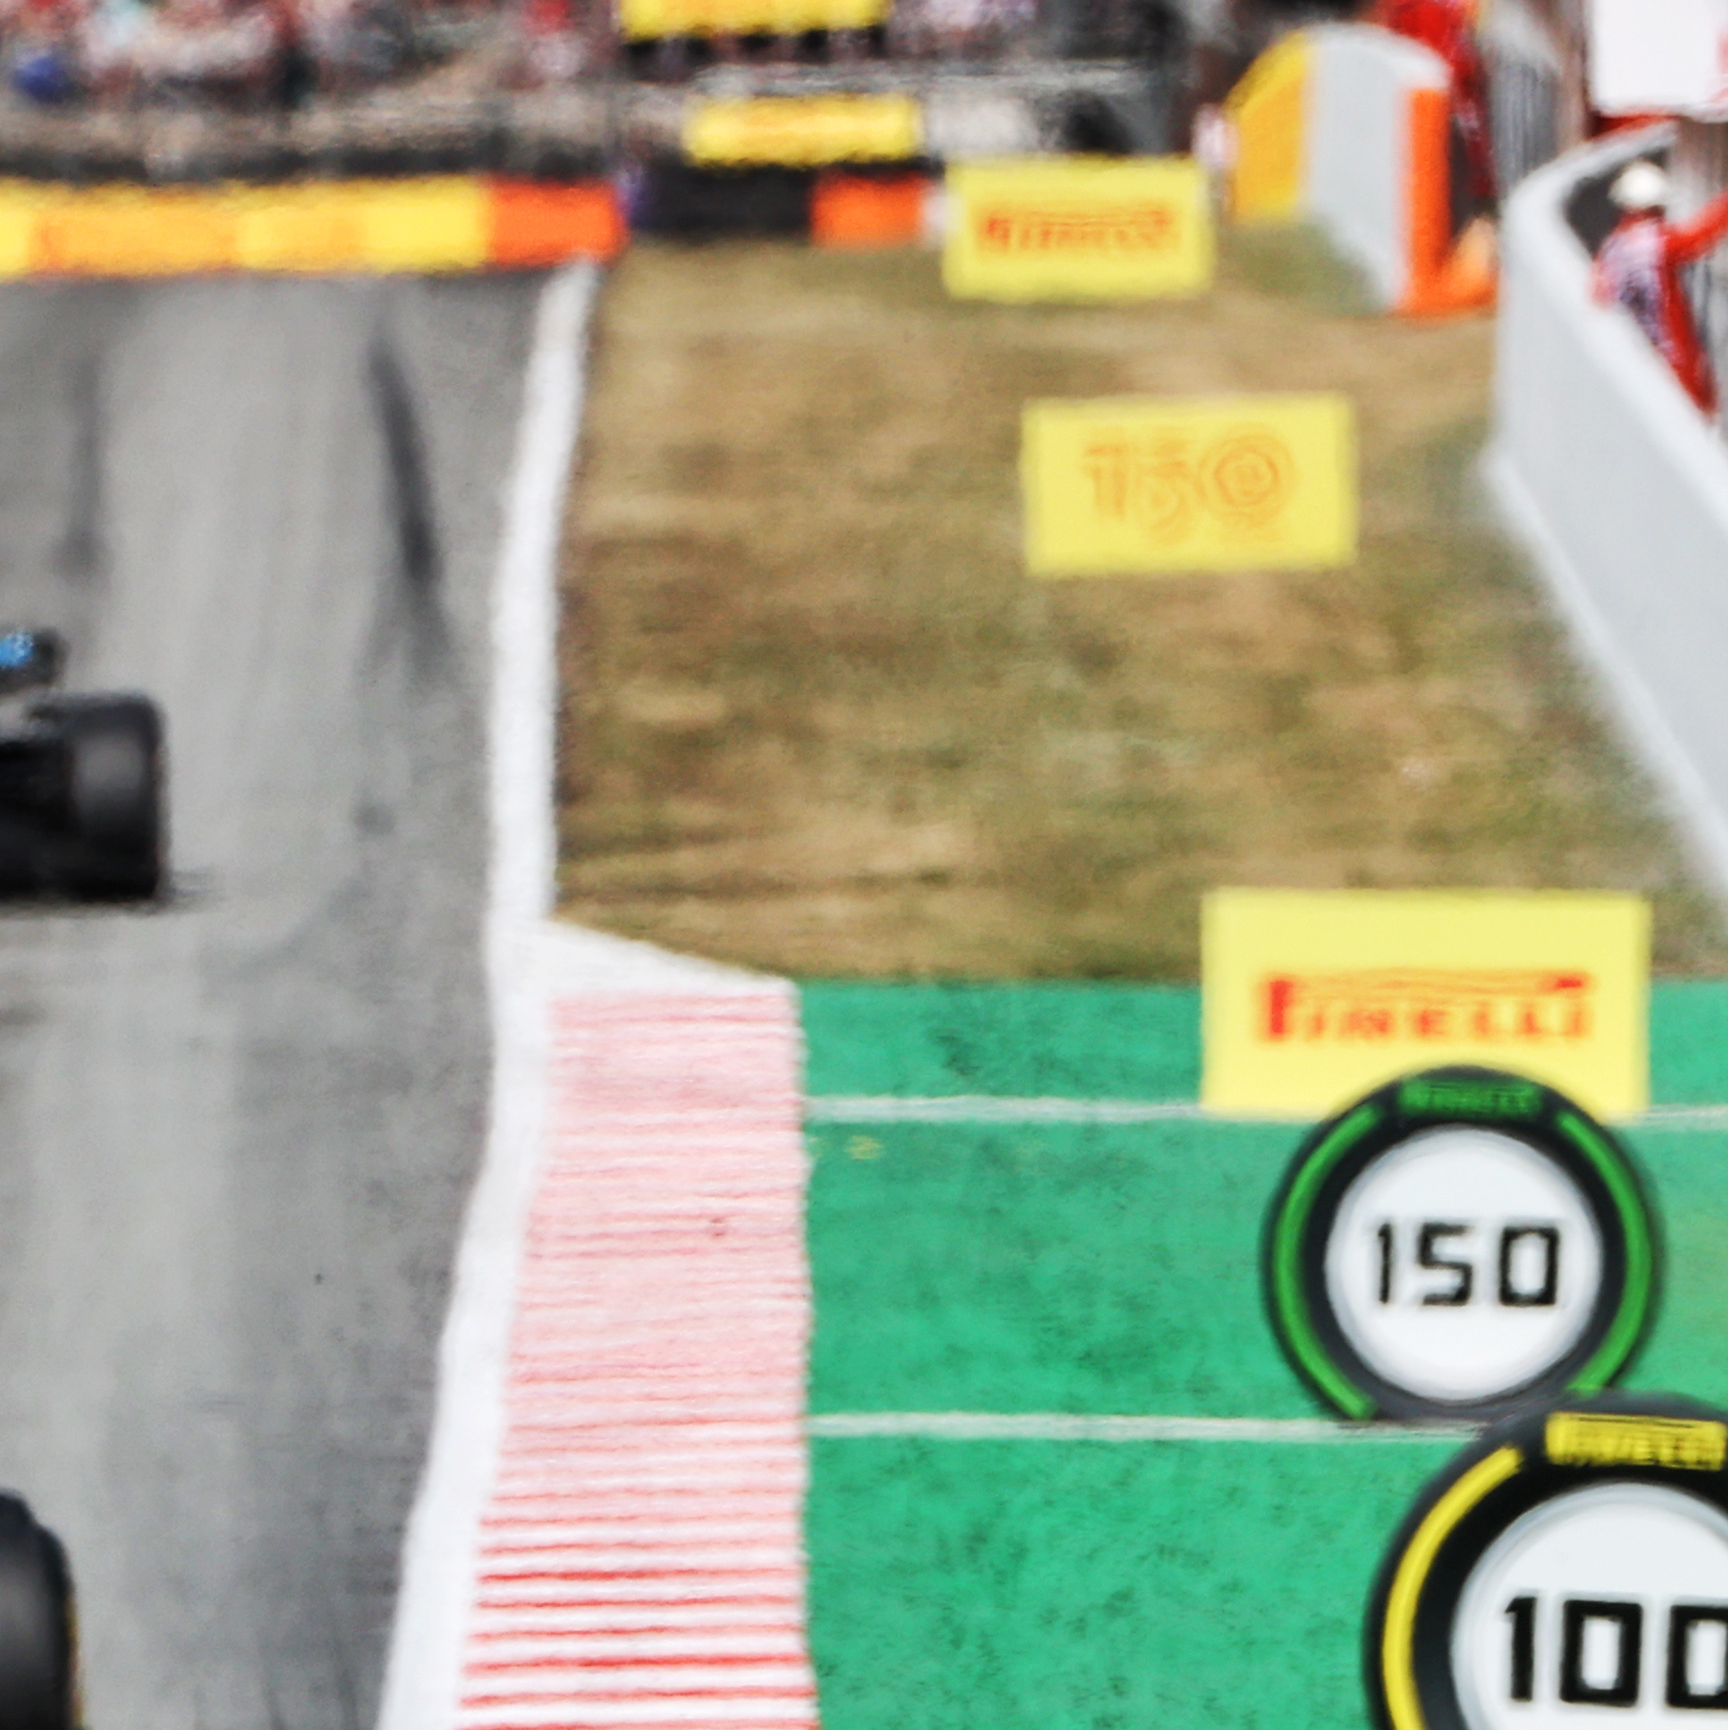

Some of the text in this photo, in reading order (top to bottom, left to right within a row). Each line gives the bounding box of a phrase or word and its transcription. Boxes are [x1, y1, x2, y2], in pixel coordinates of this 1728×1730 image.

[1261, 967, 1591, 1043] PIRELLI
[1377, 1223, 1560, 1306] 150
[1505, 1596, 1728, 1709] 100
